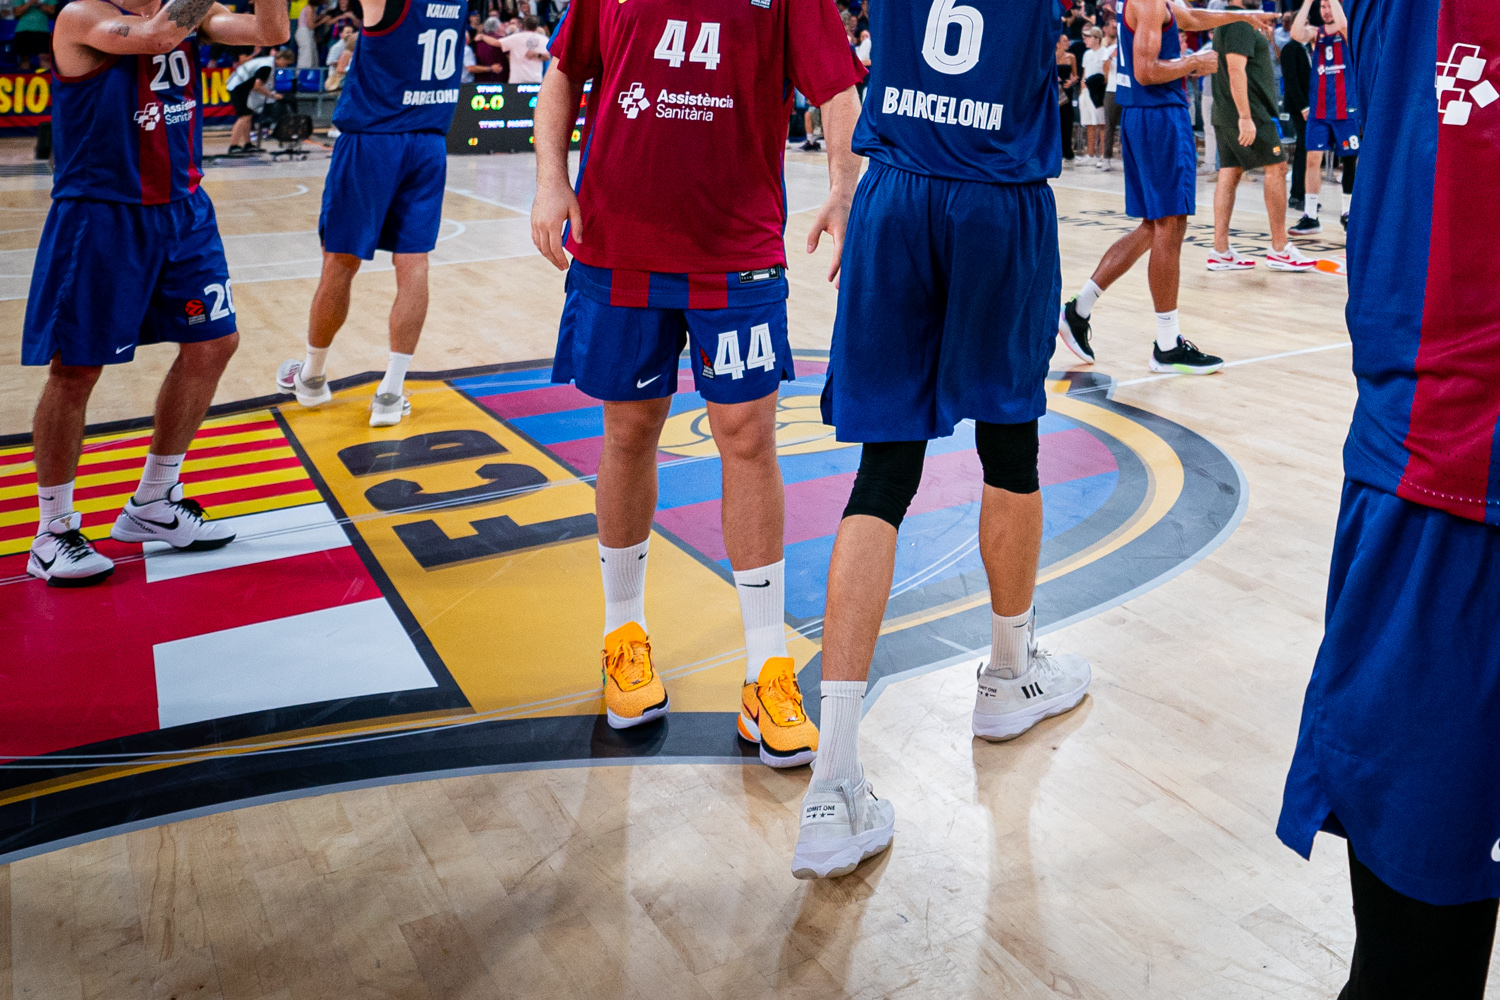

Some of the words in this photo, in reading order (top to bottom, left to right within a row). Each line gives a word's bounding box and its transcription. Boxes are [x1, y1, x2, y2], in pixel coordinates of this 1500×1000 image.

[417, 29, 459, 81] 10
[654, 19, 720, 70] 44
[149, 50, 190, 91] 20
[655, 103, 714, 122] Sanitària
[656, 88, 734, 109] Assistència
[881, 86, 1004, 131] BARCELONA
[714, 322, 776, 380] 44
